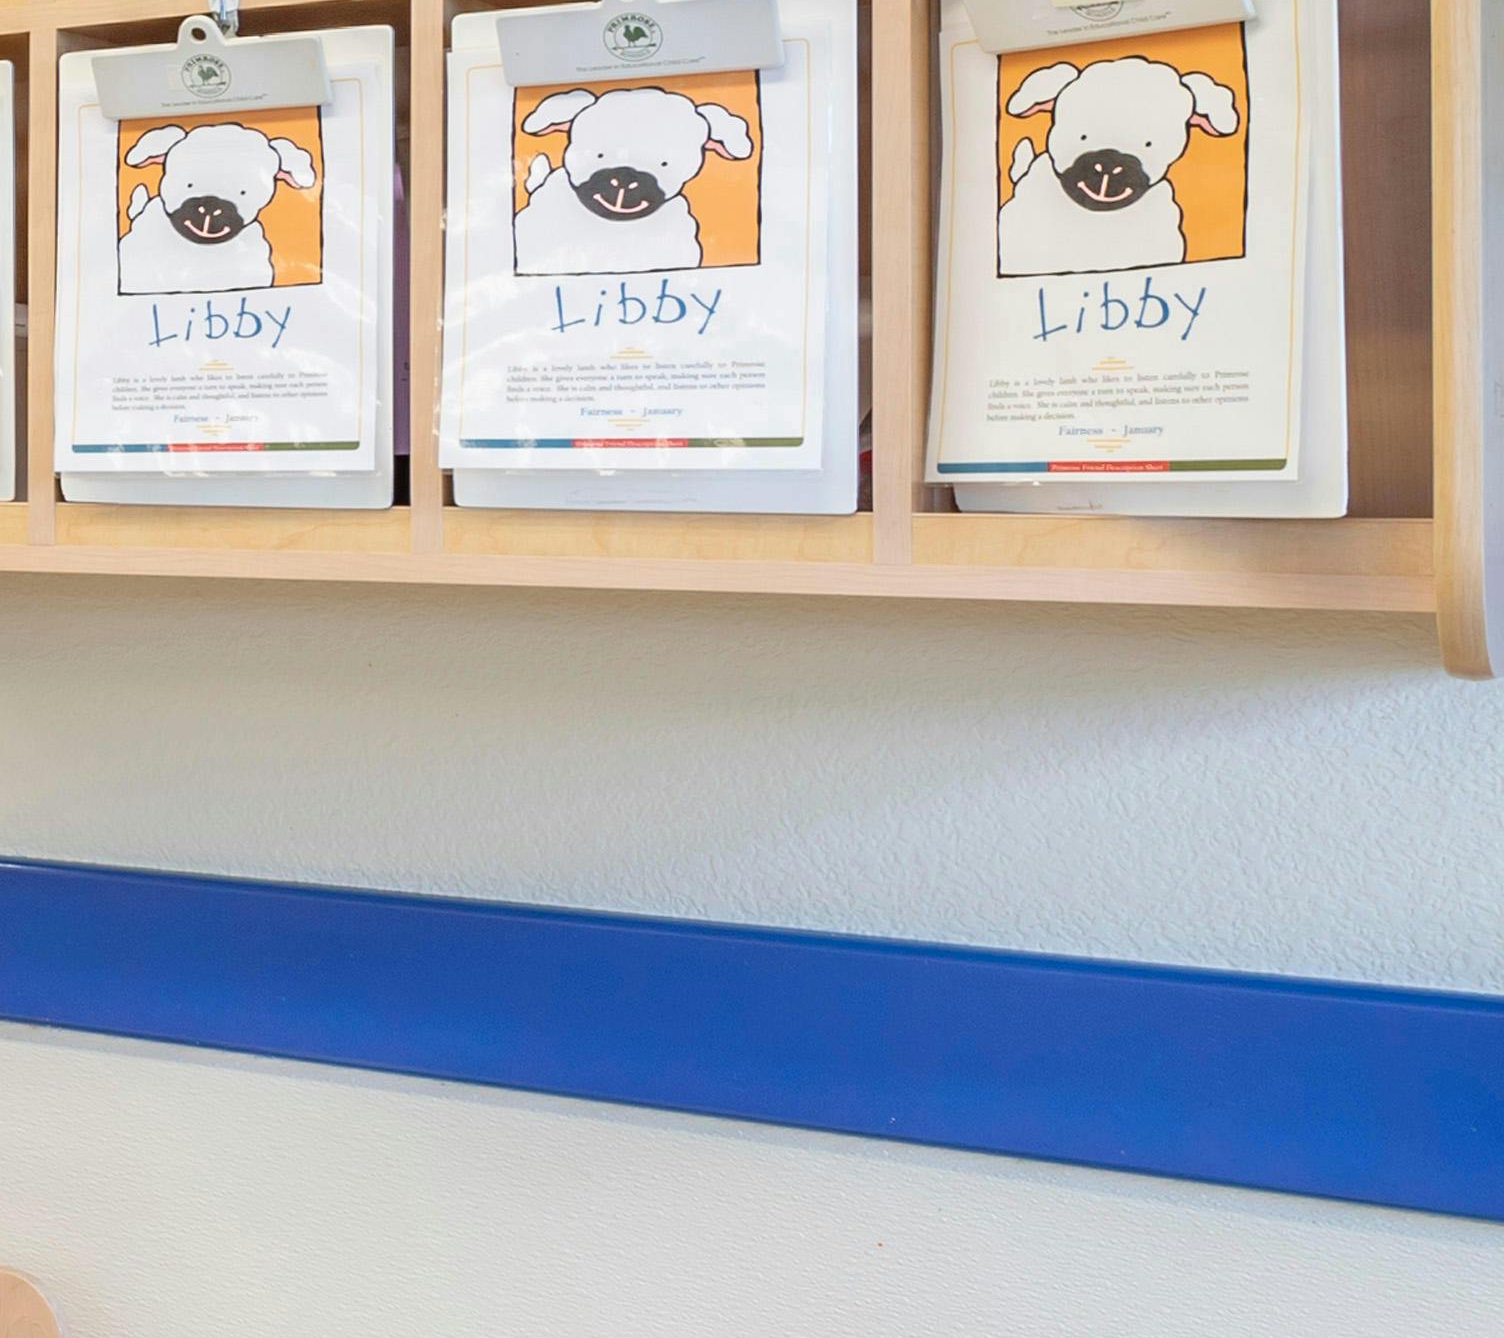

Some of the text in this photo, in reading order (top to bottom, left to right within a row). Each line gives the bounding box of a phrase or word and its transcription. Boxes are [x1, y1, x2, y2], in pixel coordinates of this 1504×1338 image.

[608, 15, 656, 34] PRIMROSE
[550, 278, 721, 336] Libby
[1033, 276, 1206, 343] Libby
[149, 303, 292, 351] Libby
[580, 406, 684, 418] Fairness January
[1058, 424, 1104, 437] Fairness
[1122, 424, 1164, 438] January
